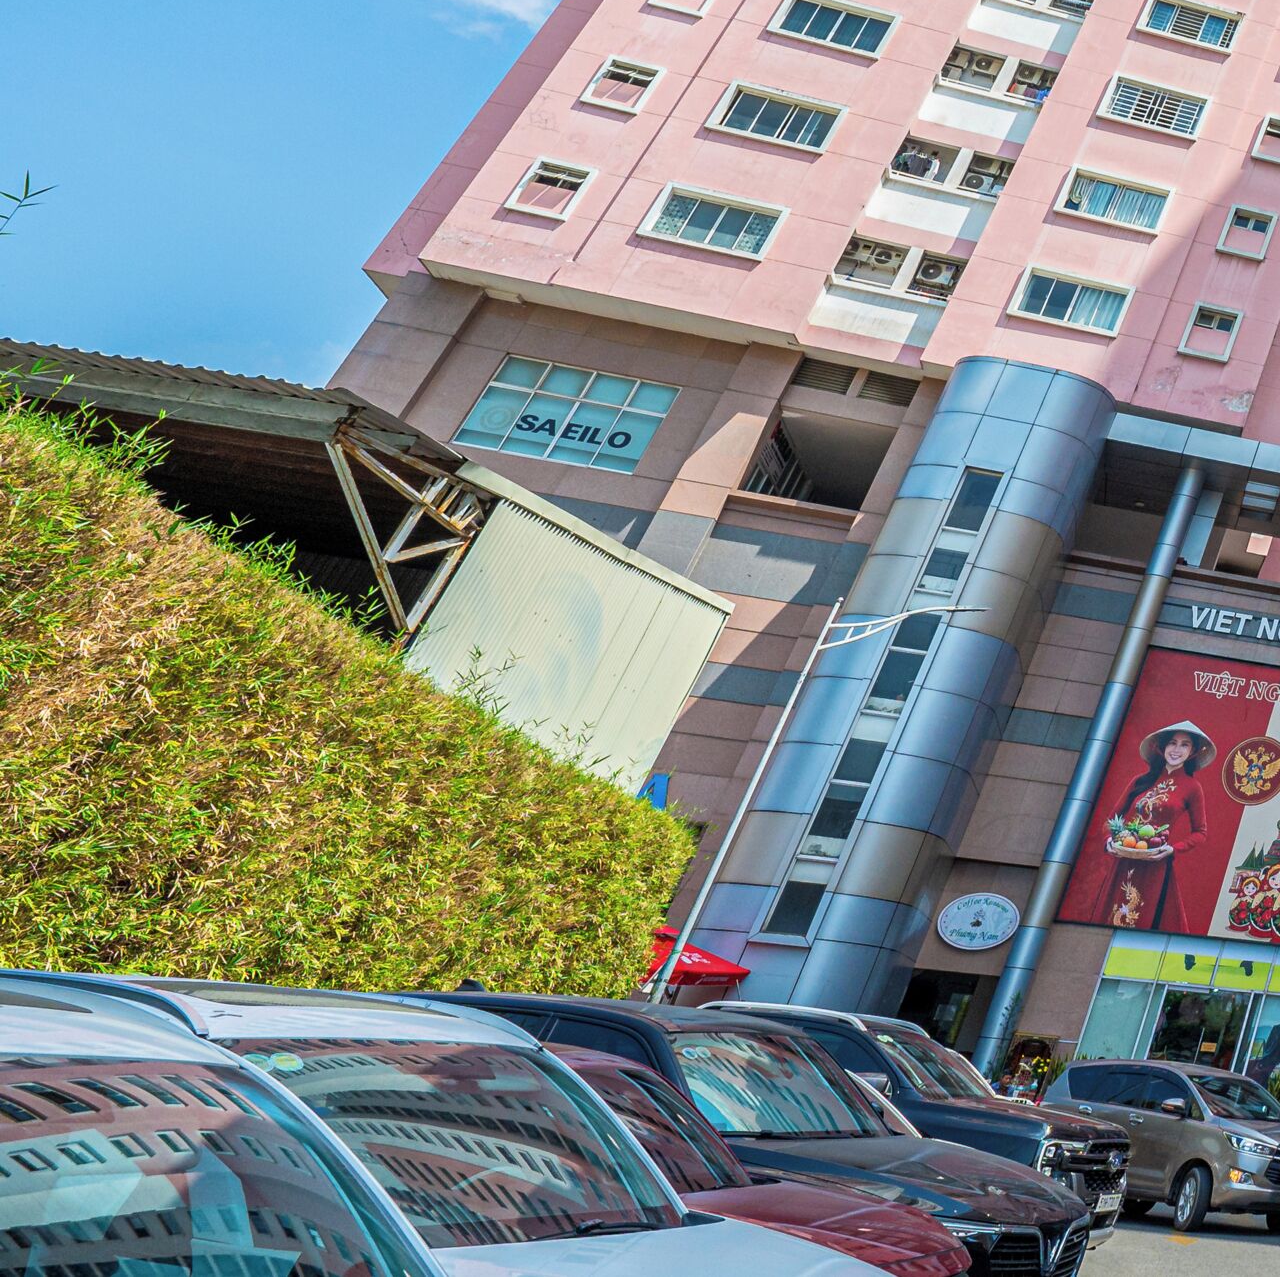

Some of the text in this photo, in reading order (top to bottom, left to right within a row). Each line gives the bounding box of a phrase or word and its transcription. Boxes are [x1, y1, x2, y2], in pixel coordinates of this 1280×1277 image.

[515, 414, 632, 449] SAEILO
[1191, 605, 1253, 636] VIET
[1194, 670, 1245, 699] VIỆT
